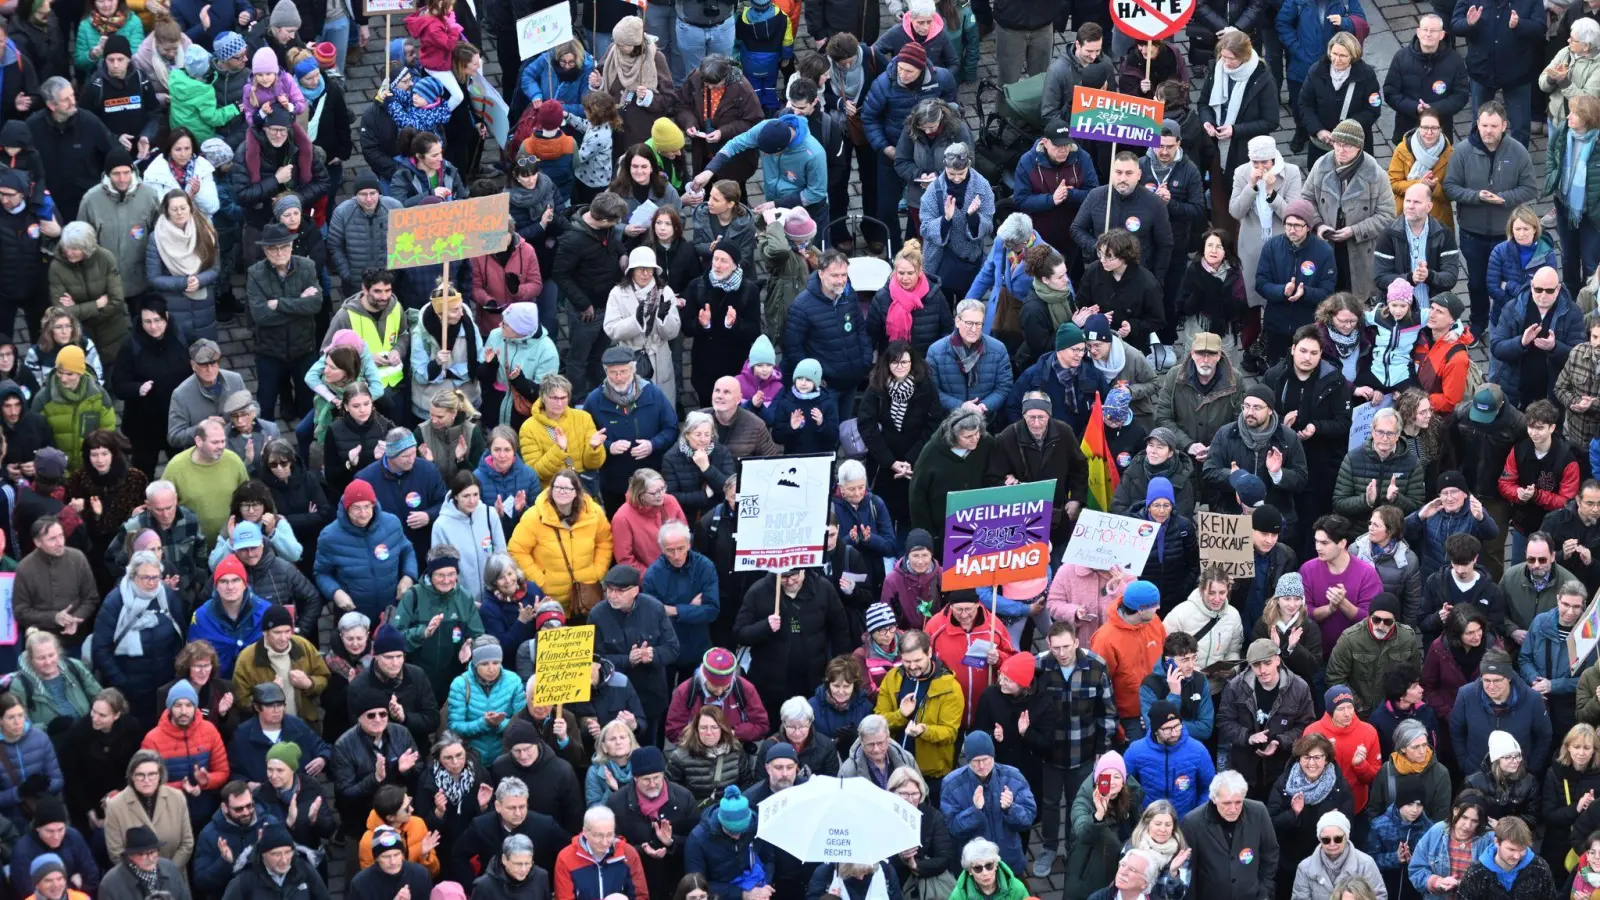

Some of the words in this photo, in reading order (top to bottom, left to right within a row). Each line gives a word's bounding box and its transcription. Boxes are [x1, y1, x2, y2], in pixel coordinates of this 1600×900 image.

[1117, 0, 1181, 18] HATE
[1080, 92, 1156, 120] WEILHEIM
[1096, 111, 1128, 124] zeigt
[1076, 115, 1154, 142] HALTUNG
[394, 200, 480, 229] DEMOKRATIE
[765, 510, 810, 529] HUY
[955, 499, 1044, 523] WEILHEIM
[1200, 514, 1239, 534] KEIN
[742, 557, 755, 565] Die
[755, 554, 816, 569] PARTEI
[955, 549, 1040, 577] HALTUNG
[537, 648, 591, 662] Klimakrise
[539, 671, 577, 683] Fakten
[828, 828, 849, 836] OMAS
[823, 849, 852, 857] RECHTS
